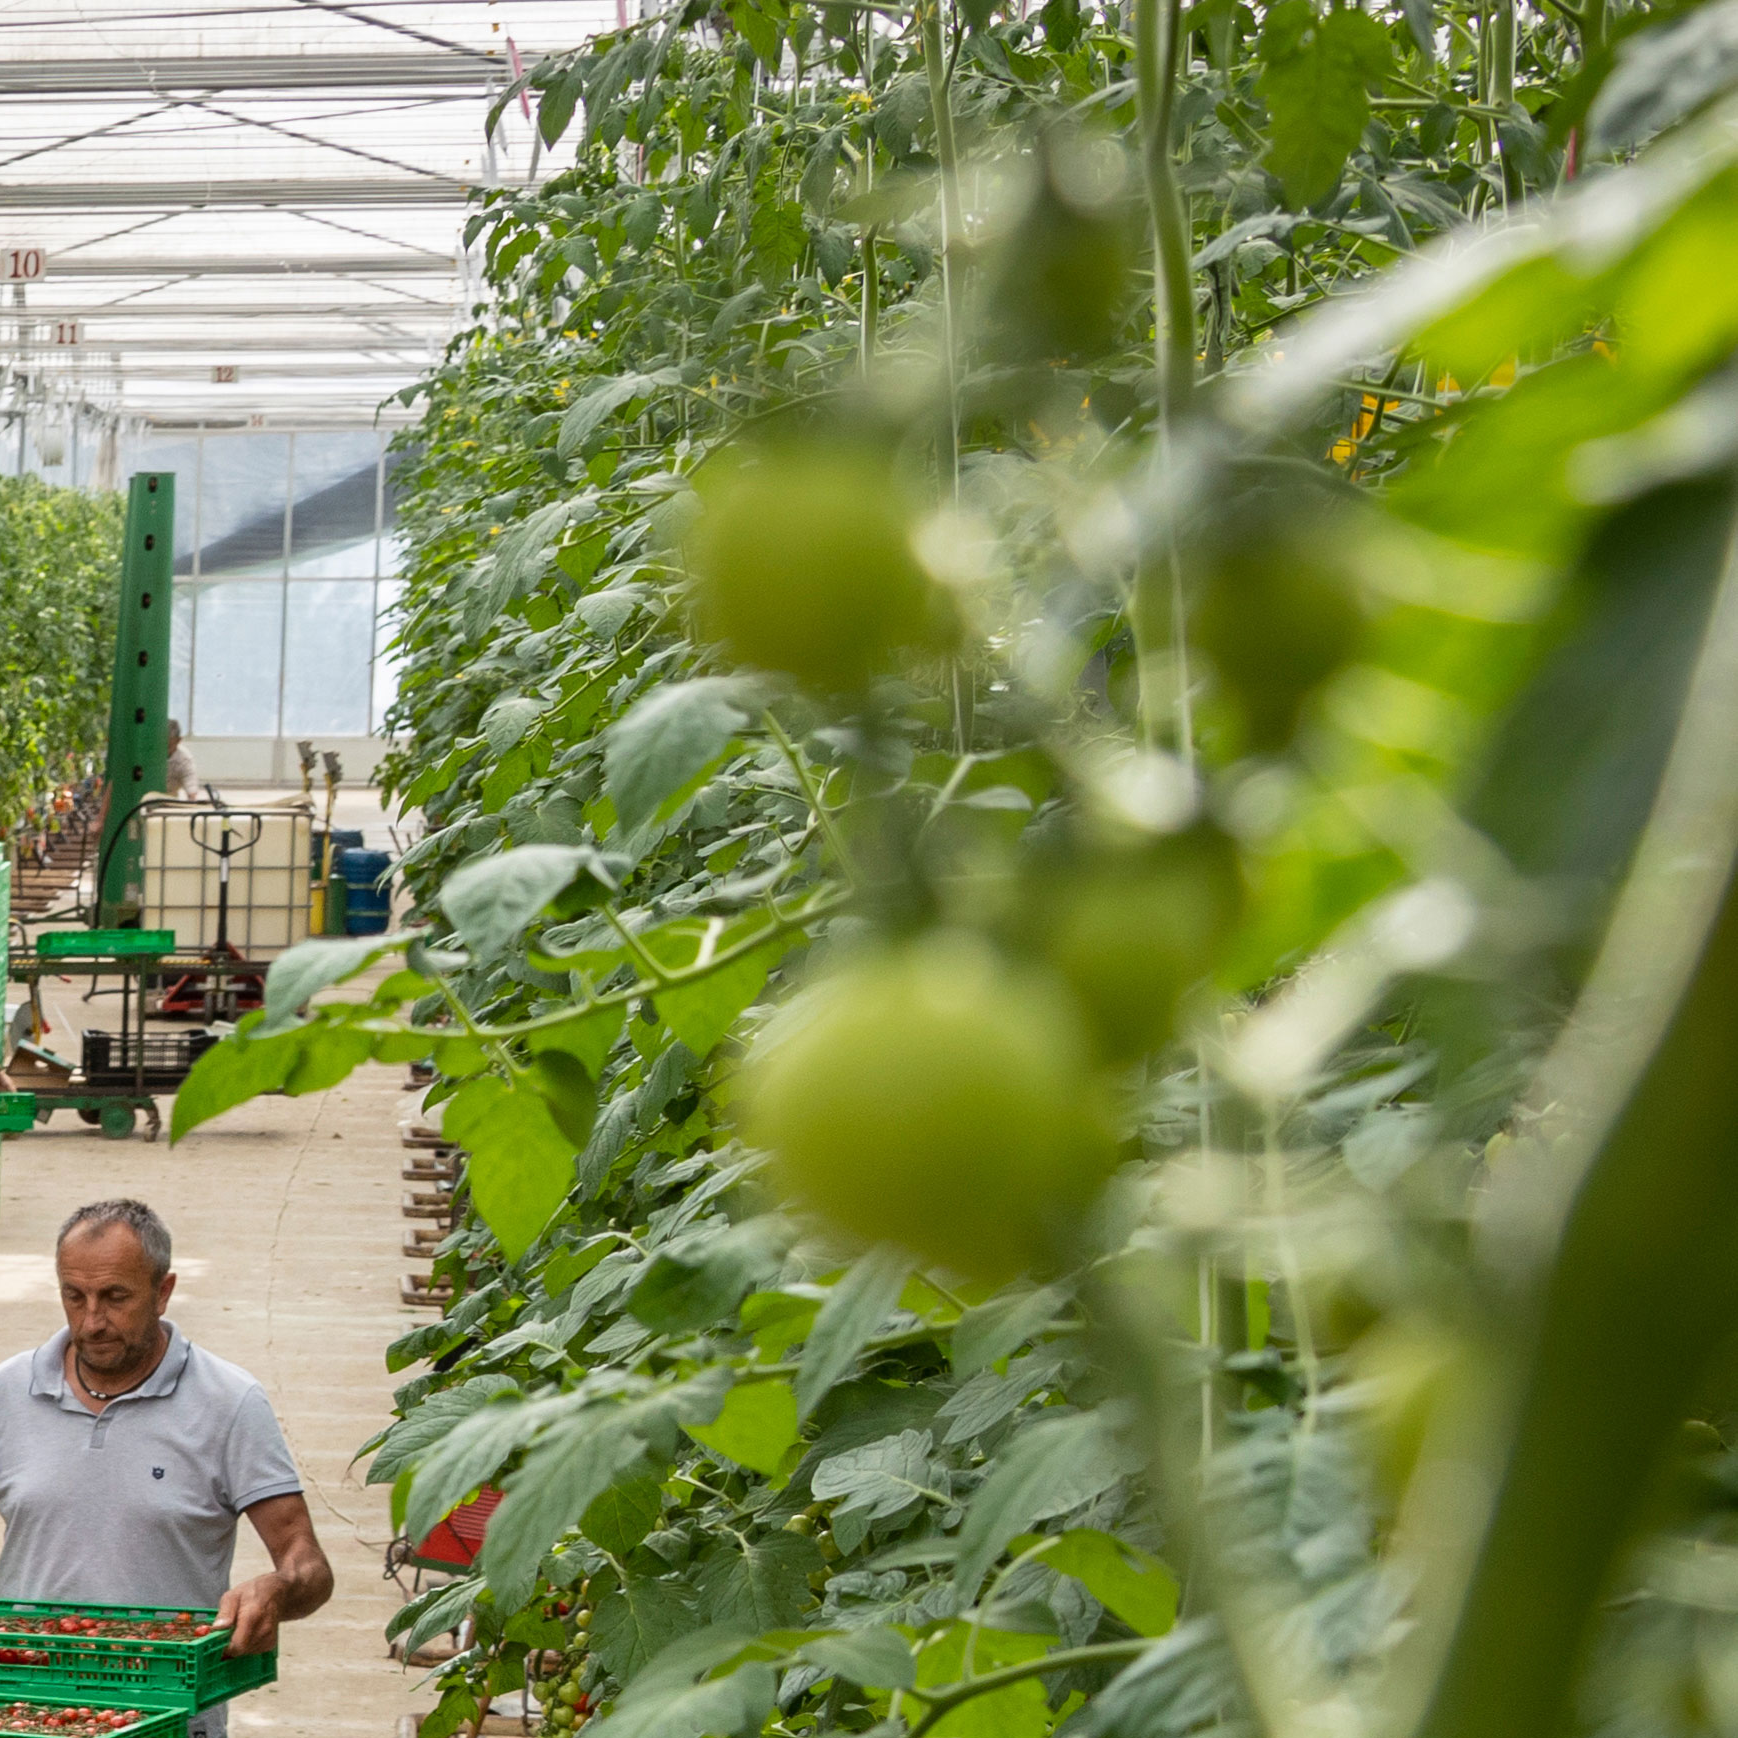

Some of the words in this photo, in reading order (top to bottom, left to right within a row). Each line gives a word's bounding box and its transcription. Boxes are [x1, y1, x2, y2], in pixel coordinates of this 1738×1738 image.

[8, 249, 40, 279] 10
[55, 323, 78, 345] 11
[215, 365, 235, 383] 12
